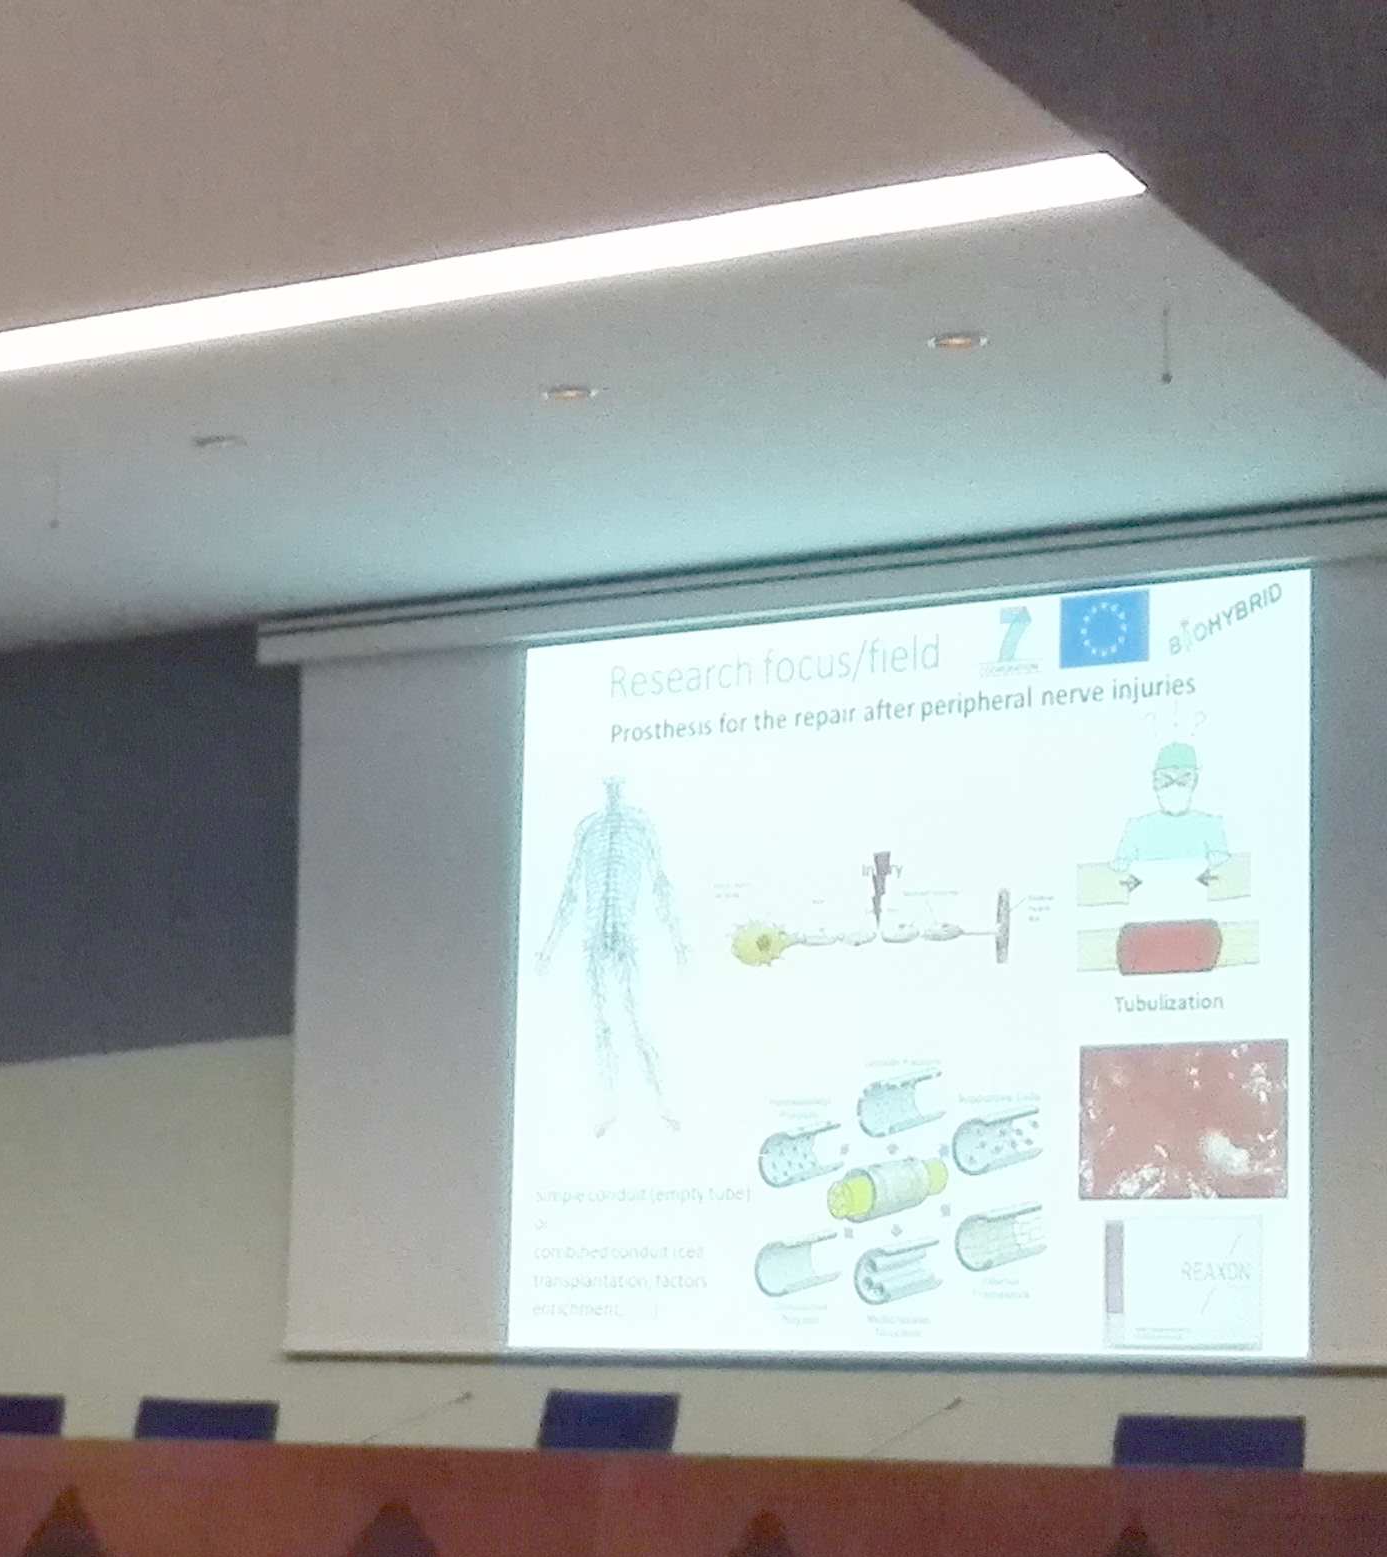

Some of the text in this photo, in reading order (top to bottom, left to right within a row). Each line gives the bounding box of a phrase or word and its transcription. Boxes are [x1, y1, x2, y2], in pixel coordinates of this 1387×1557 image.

[611, 632, 940, 698] Research focus/field
[611, 673, 1196, 743] Prosthesis for the repair after peripheral nerve injuries
[1114, 993, 1225, 1013] Tubulization
